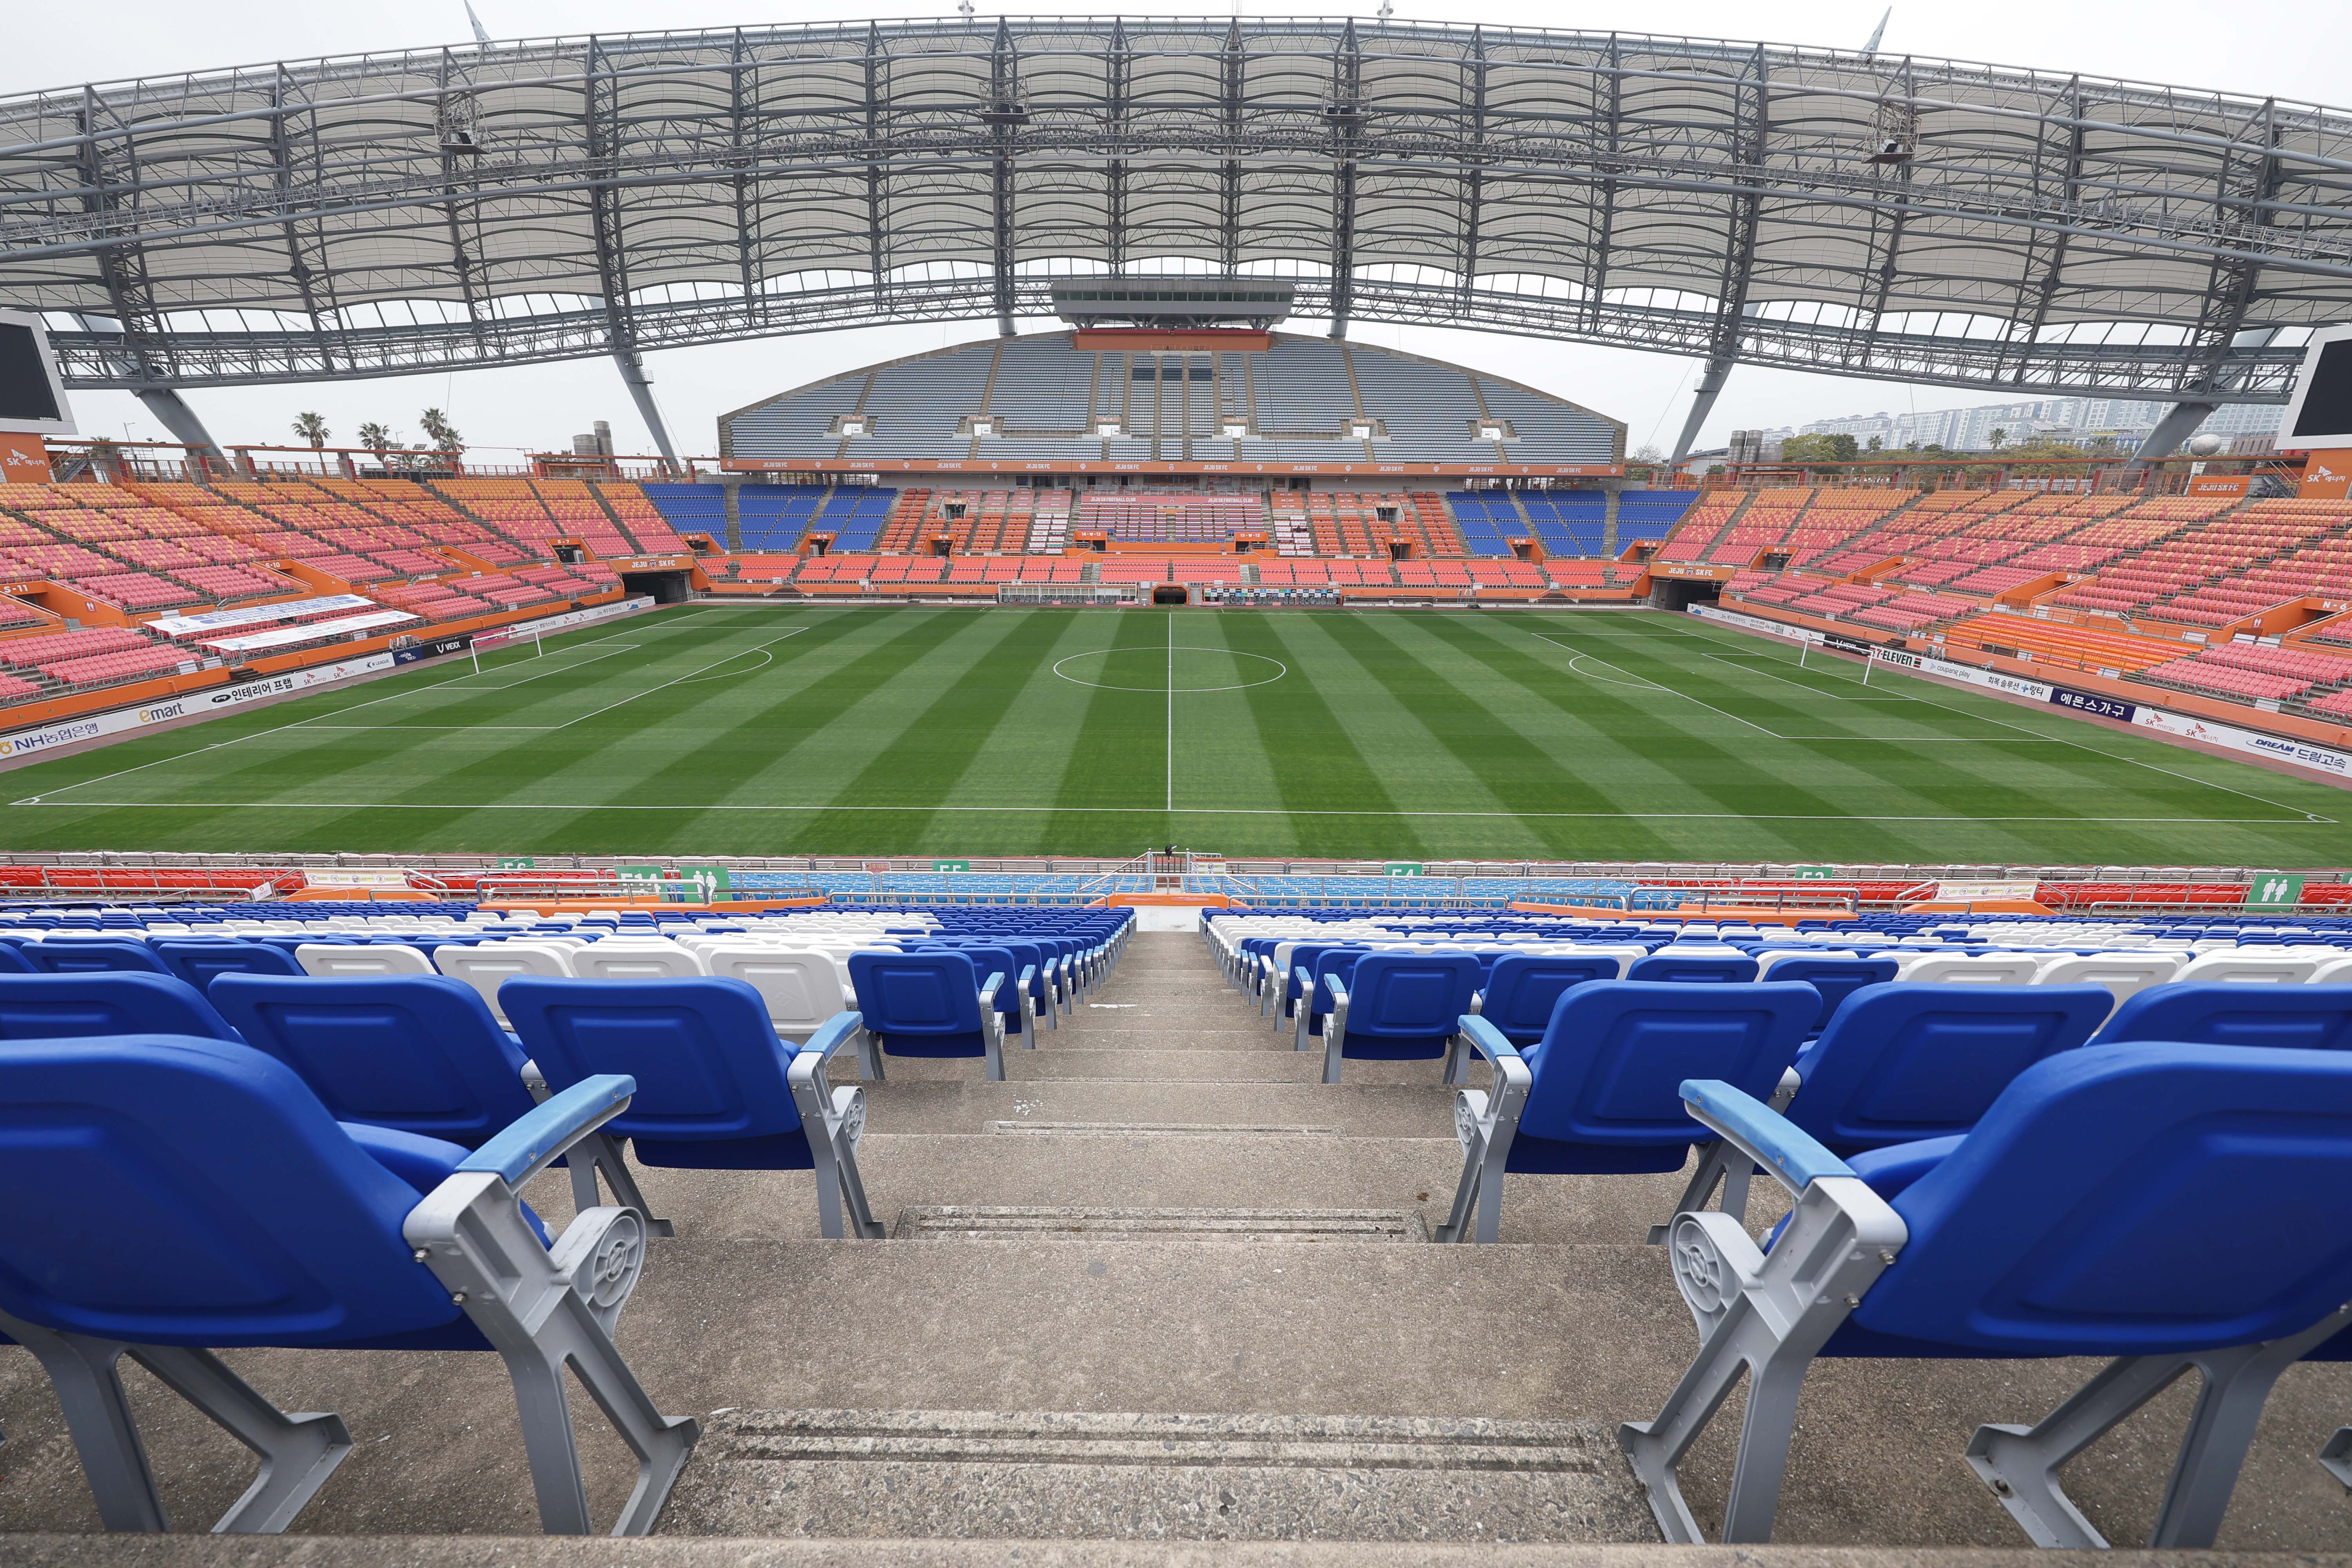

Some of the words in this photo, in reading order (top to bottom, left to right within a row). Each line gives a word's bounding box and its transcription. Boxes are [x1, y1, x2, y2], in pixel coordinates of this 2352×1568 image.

[6, 457, 21, 466] SK
[445, 641, 461, 651] VEXX
[1937, 665, 1958, 676] coupang
[1958, 670, 1971, 679] play
[231, 683, 272, 701] 인테리어
[274, 677, 293, 690] 프랩
[1988, 676, 2000, 686] 회복
[2000, 679, 2020, 690] 솔루션
[2030, 686, 2044, 697] 링티
[139, 702, 184, 723] emart
[2060, 692, 2124, 717] 에몬스가구
[2145, 718, 2155, 726] SK
[2157, 721, 2176, 732] energy
[14, 722, 98, 750] NH농협은행
[2186, 729, 2196, 737] SK
[2201, 733, 2219, 743] 에너지
[2255, 739, 2295, 754] DREAM
[2297, 749, 2346, 769] 드림고속
